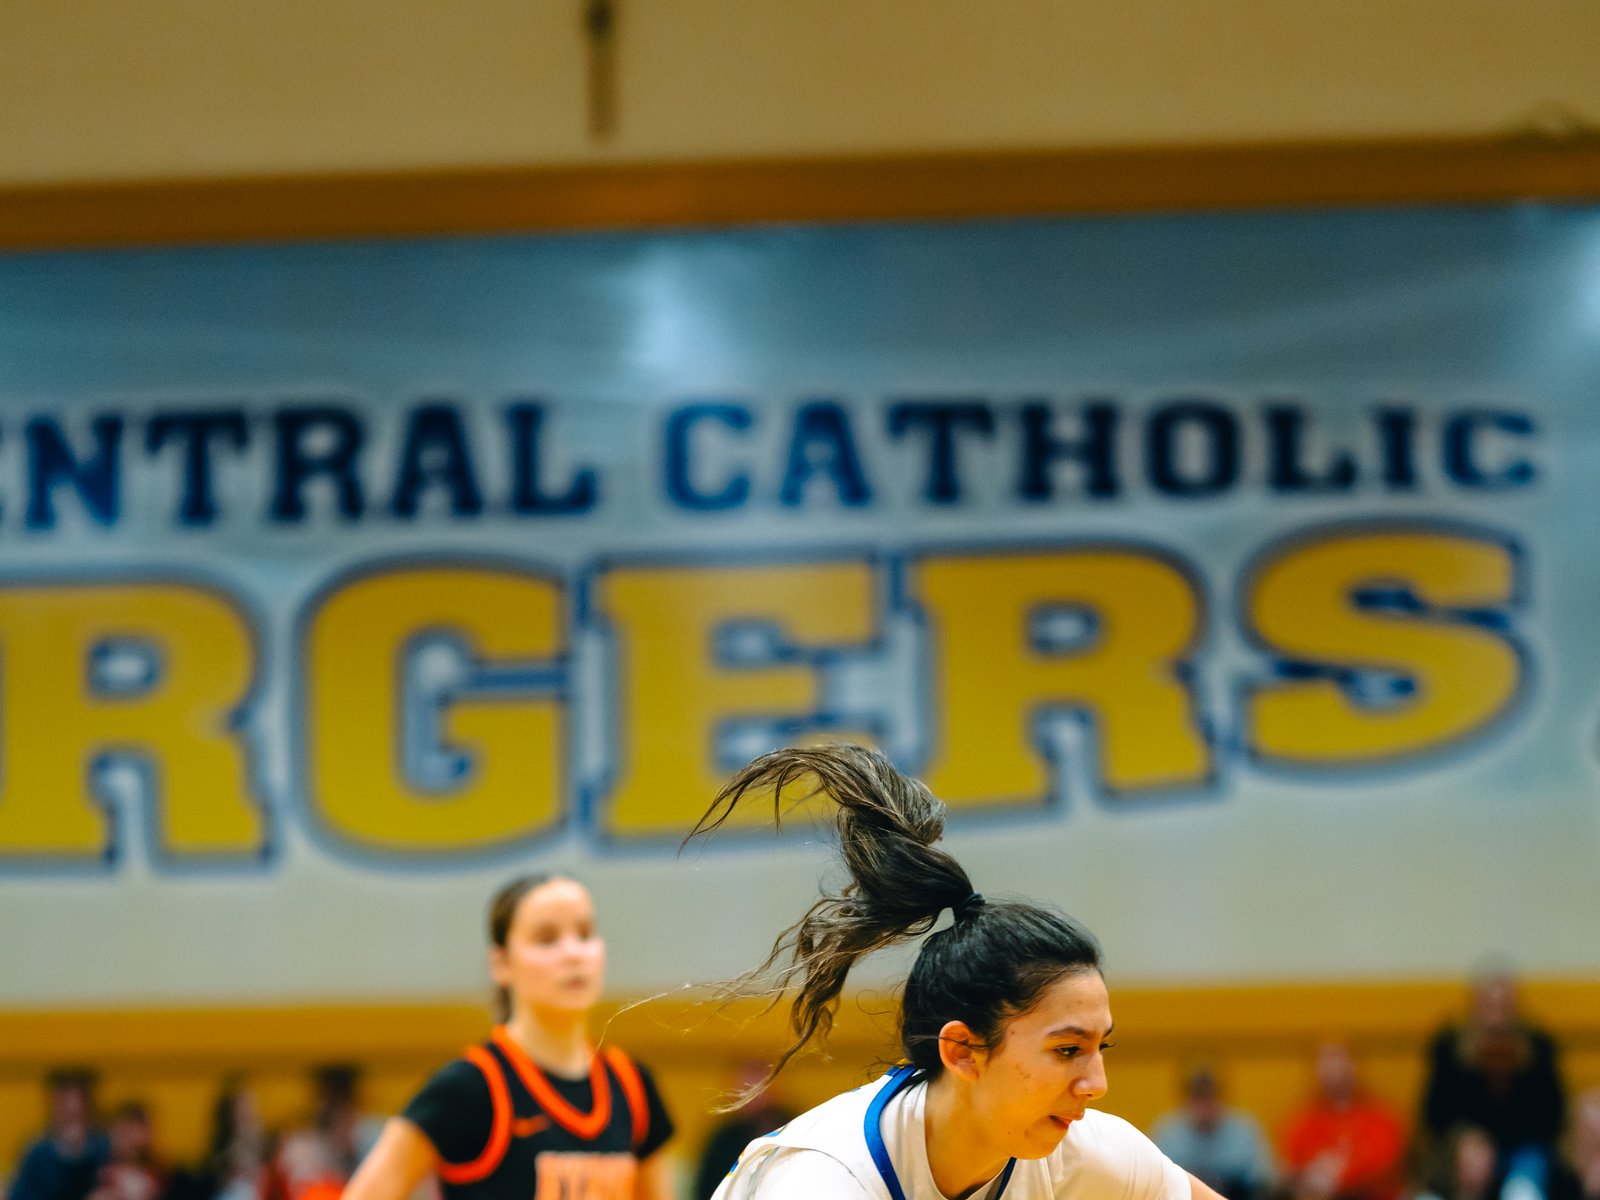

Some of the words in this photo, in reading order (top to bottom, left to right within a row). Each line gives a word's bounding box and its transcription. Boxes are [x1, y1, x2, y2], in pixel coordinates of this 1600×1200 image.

[0, 402, 598, 530] NTRAL
[662, 400, 1540, 508] CATHOLIC
[0, 516, 1532, 872] RGERS
